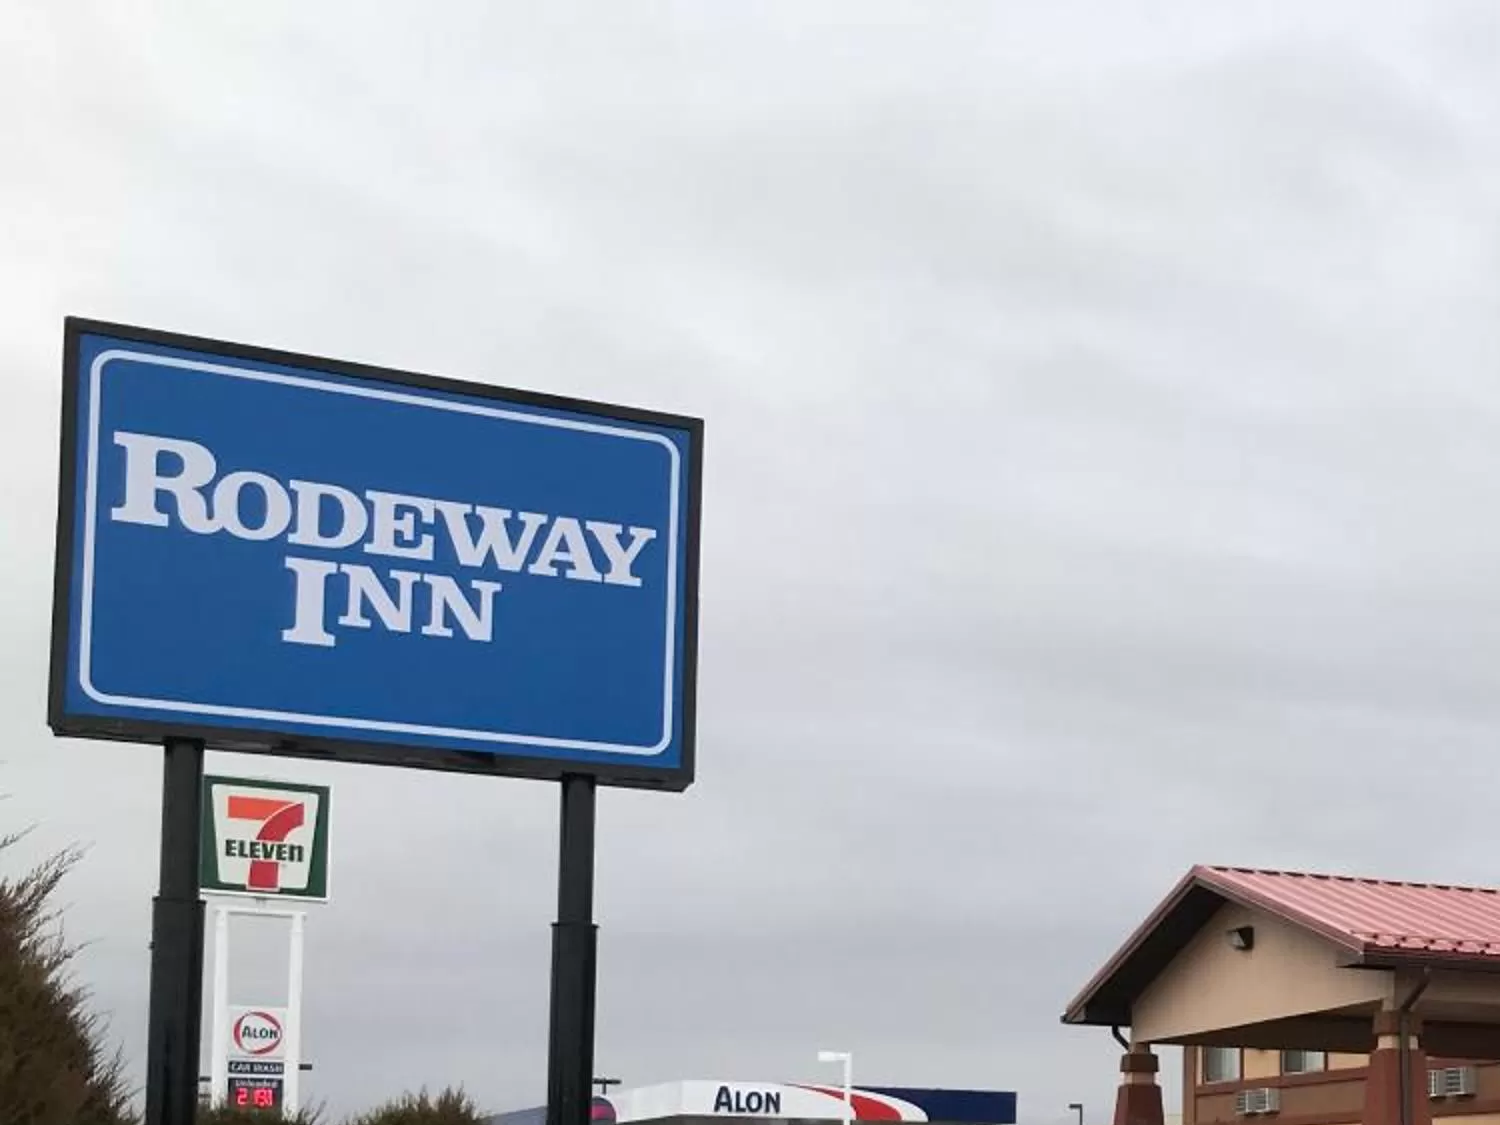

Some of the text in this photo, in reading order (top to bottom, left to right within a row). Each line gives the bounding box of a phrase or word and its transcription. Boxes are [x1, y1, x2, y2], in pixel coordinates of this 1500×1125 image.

[112, 431, 657, 588] RODEWAY
[282, 556, 502, 647] INN
[227, 795, 305, 889] 7
[242, 1025, 278, 1039] ALON
[713, 1085, 781, 1114] ALON
